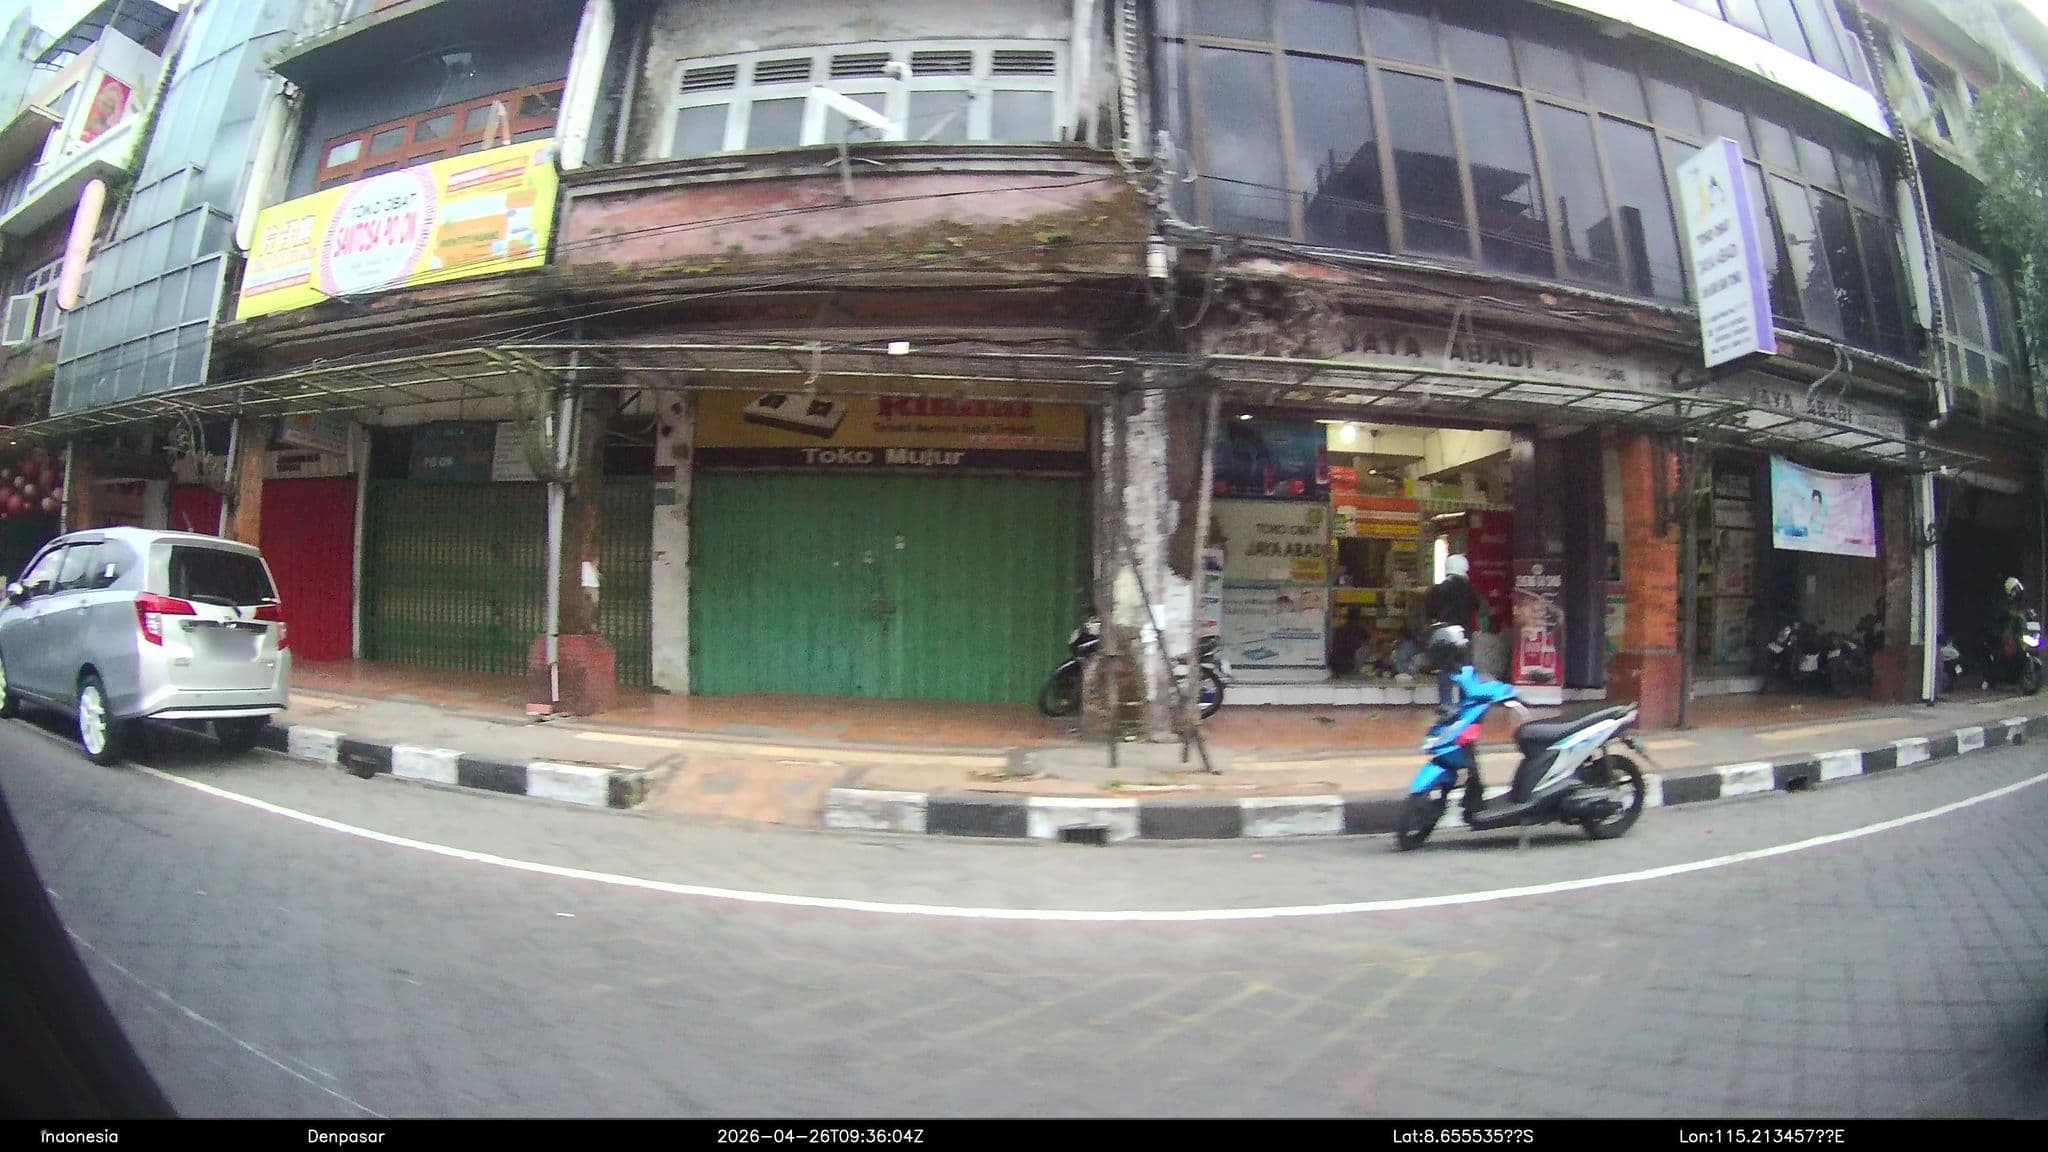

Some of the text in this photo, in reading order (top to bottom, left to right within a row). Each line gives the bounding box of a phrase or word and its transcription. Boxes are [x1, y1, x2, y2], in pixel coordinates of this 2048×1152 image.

[384, 192, 418, 211] OBAT
[1342, 329, 1422, 358] JAYA
[1450, 338, 1534, 369] ABADI
[800, 447, 966, 467] Toko Mujur
[1256, 522, 1320, 536] TOKO OBAT
[1245, 540, 1282, 556] JAYA
